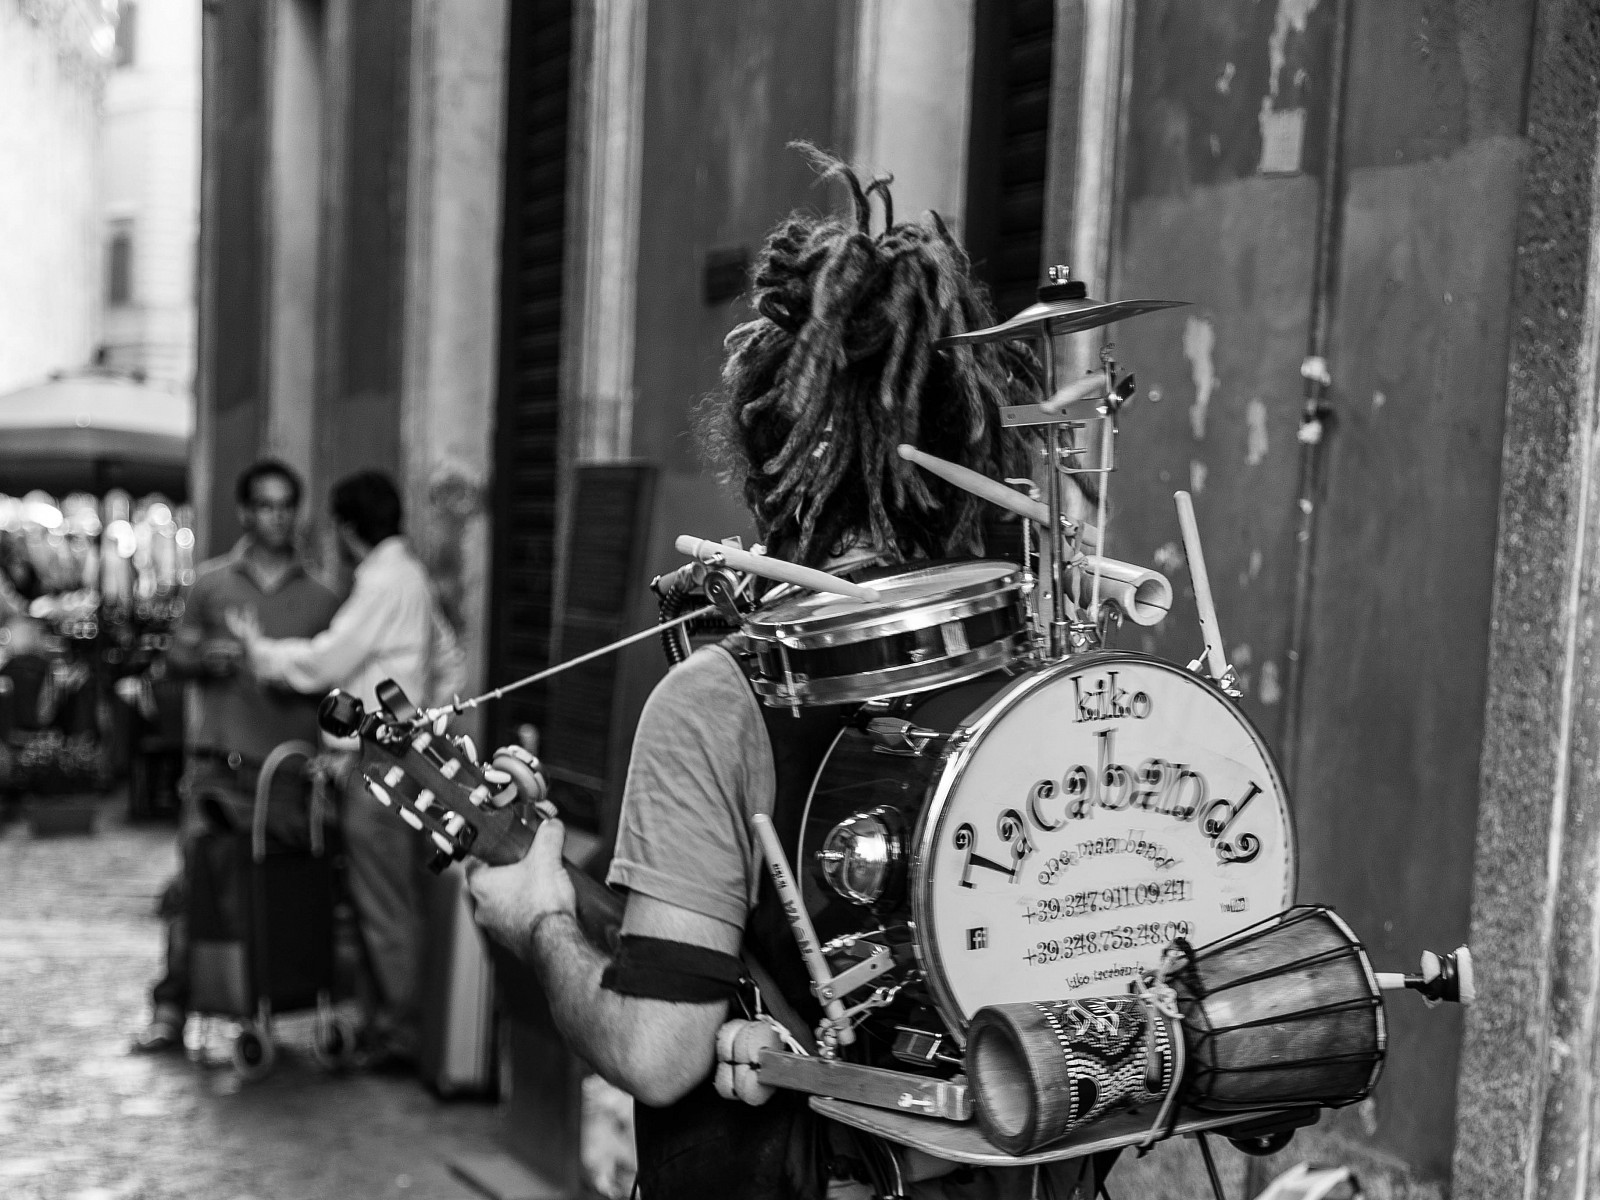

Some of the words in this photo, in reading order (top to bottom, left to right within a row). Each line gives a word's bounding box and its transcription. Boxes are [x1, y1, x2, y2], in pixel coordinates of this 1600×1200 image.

[1069, 671, 1153, 723] kiko
[1038, 849, 1075, 885] one
[1076, 836, 1122, 859] man
